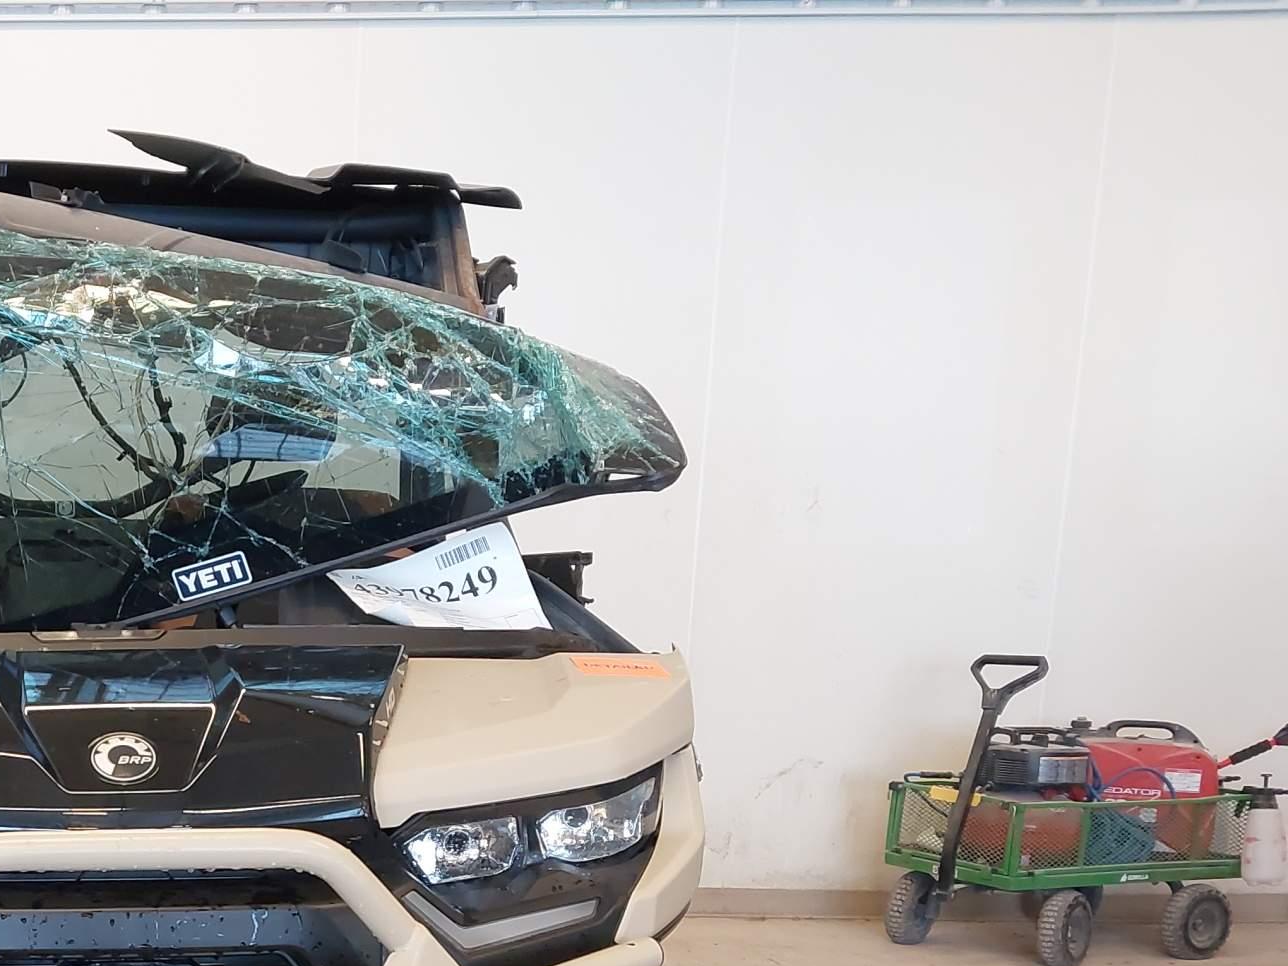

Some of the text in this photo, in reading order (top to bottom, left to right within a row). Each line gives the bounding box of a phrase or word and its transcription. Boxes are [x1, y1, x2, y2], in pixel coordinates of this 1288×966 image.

[179, 560, 244, 593] YETI
[117, 754, 153, 765] BRP
[1103, 787, 1162, 798] EDATOR
